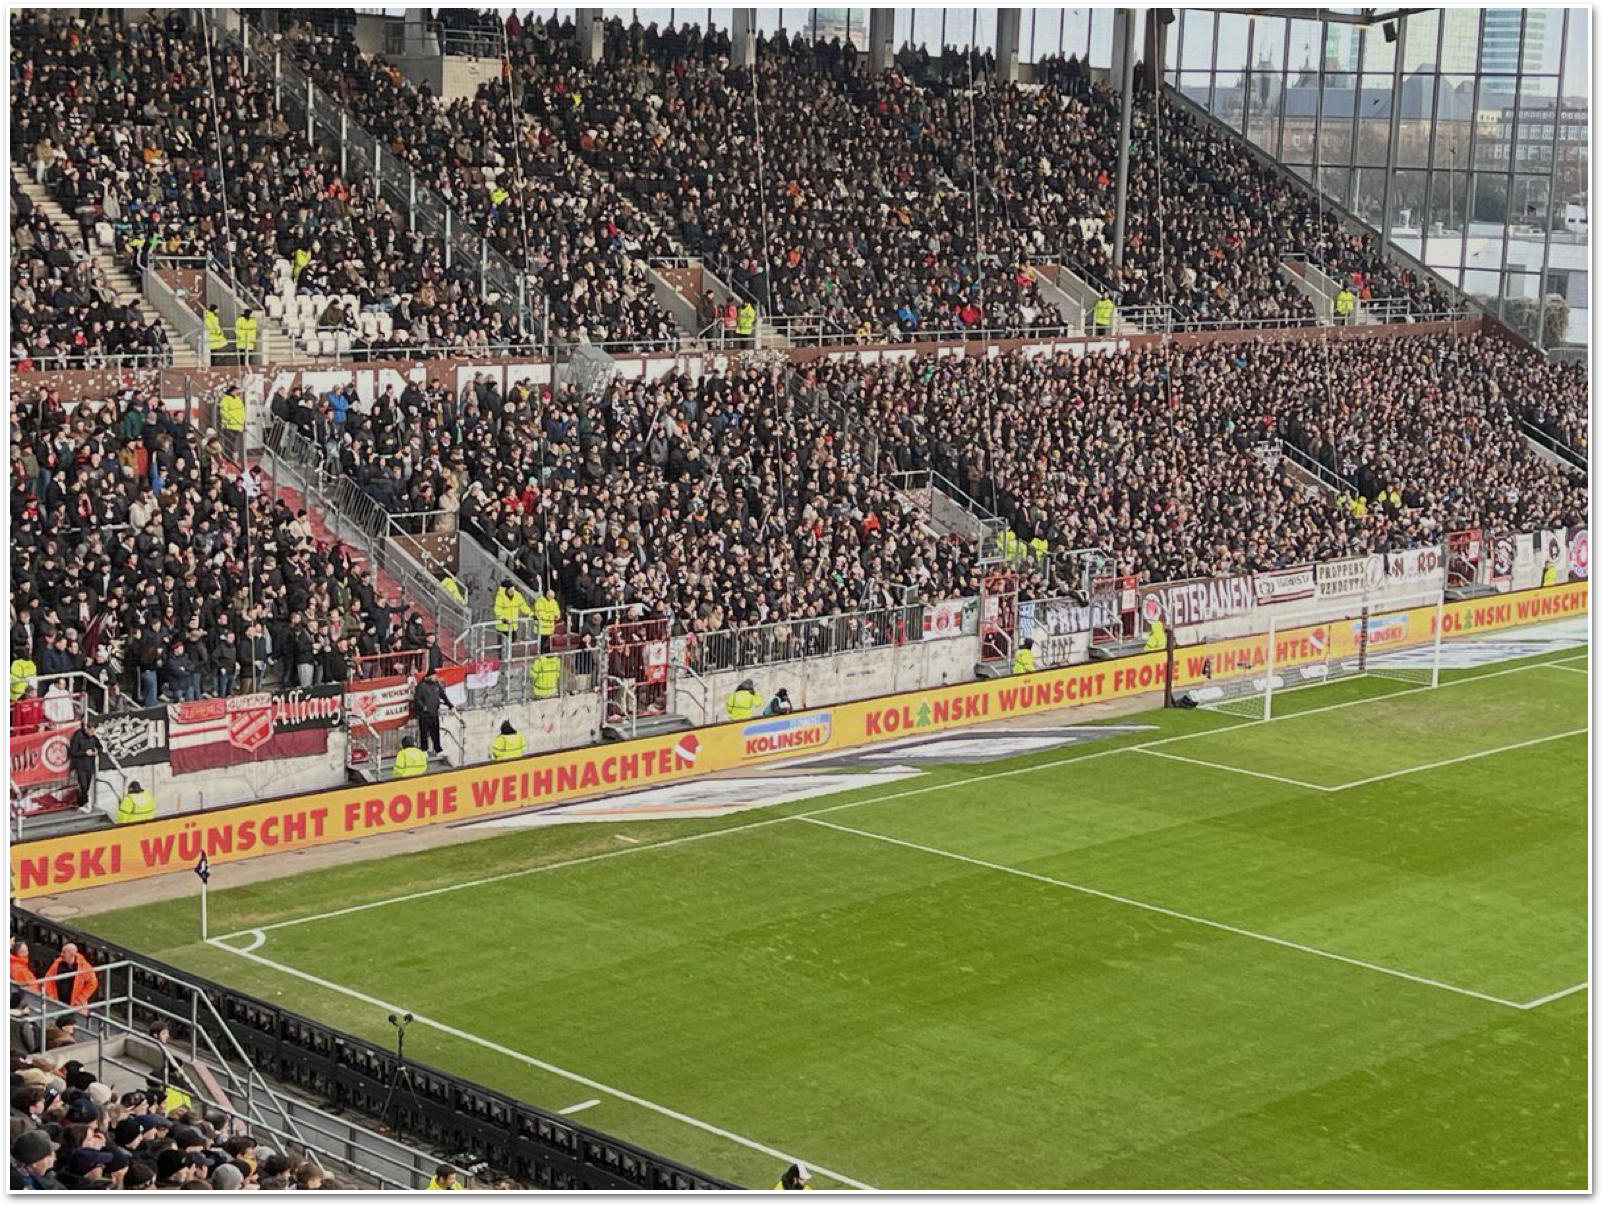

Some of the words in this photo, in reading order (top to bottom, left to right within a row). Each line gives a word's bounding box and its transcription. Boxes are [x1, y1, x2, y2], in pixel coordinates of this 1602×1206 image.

[1160, 575, 1256, 625] VETERANEN
[998, 672, 1105, 711] WÜNSCHT
[745, 727, 820, 754] KOLINSKI
[141, 809, 328, 867] WÜNSCHT
[344, 785, 457, 832] FROHE
[471, 748, 694, 807] WEIHNACHTEN
